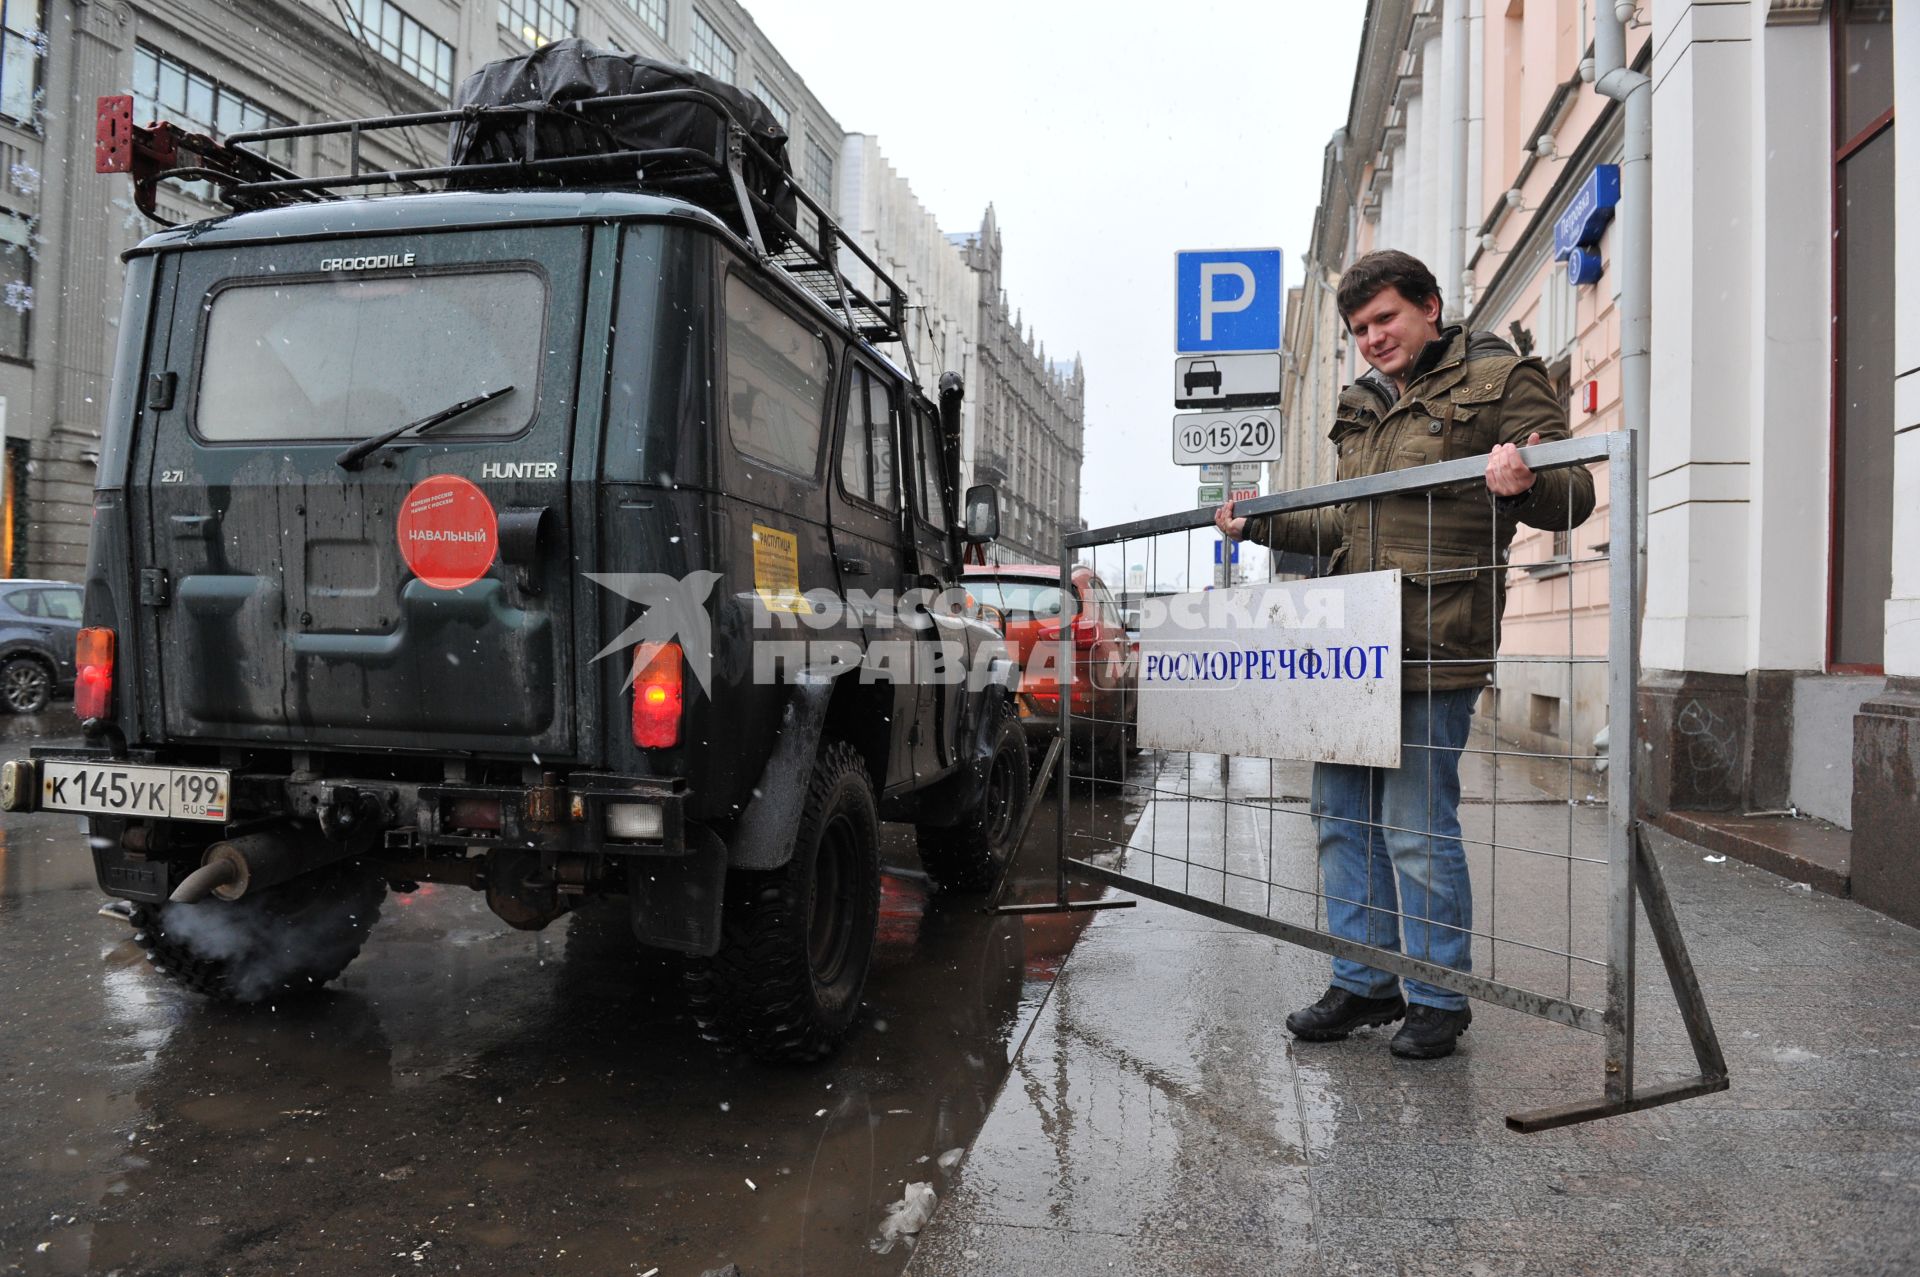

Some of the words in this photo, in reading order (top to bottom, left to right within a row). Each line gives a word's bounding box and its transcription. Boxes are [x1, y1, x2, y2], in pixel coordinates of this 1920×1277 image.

[320, 253, 415, 272] CROCODILE
[1200, 262, 1256, 341] P
[1184, 430, 1201, 447] 10
[1208, 427, 1230, 447] 15
[1240, 421, 1269, 447] 20
[482, 462, 557, 479] HUNTER
[409, 528, 487, 542] НАВАЛЬНЫЙ
[1146, 645, 1389, 681] РОСМОРРЕЧФЛОТ
[174, 774, 219, 804] 199
[183, 804, 206, 815] RUS
